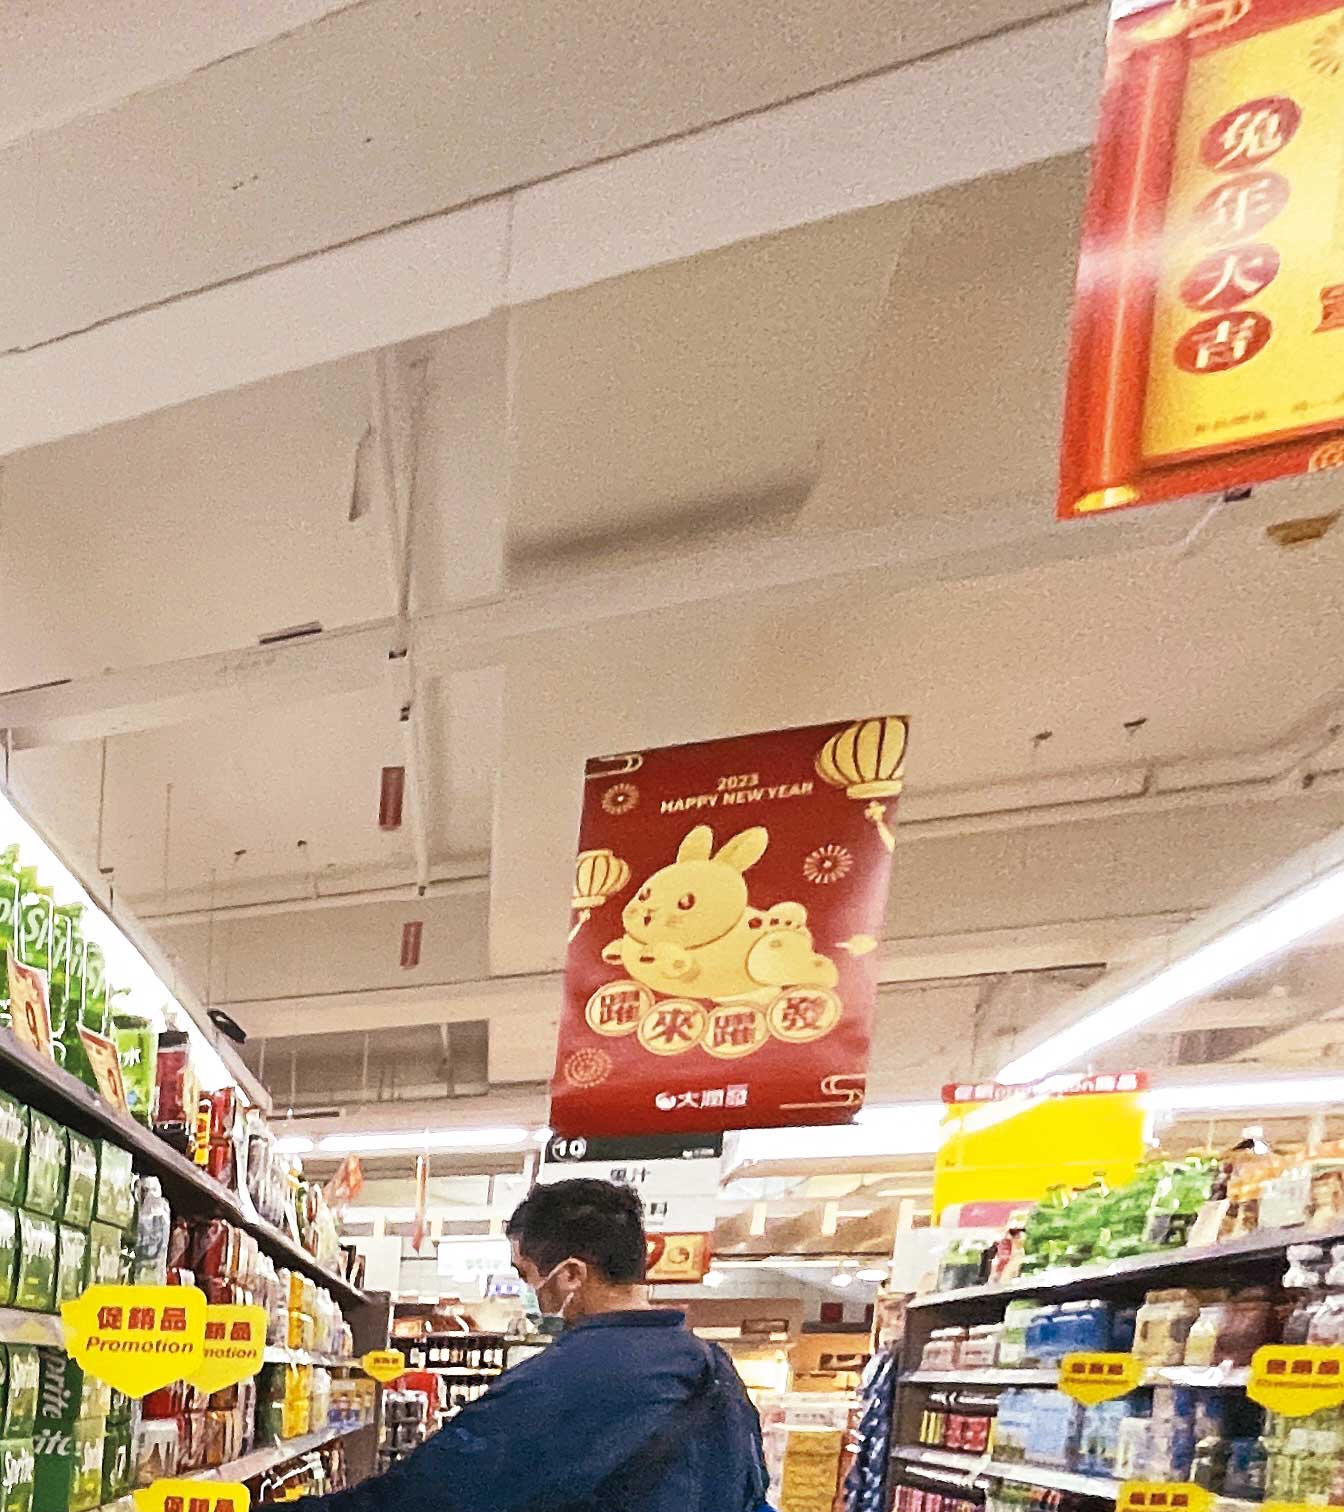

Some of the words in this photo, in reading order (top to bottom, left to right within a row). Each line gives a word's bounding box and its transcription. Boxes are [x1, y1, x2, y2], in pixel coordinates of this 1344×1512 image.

[717, 773, 759, 790] 2023
[660, 794, 718, 814] HAPPY
[722, 788, 766, 805] NEW
[85, 1336, 194, 1356] Promotion
